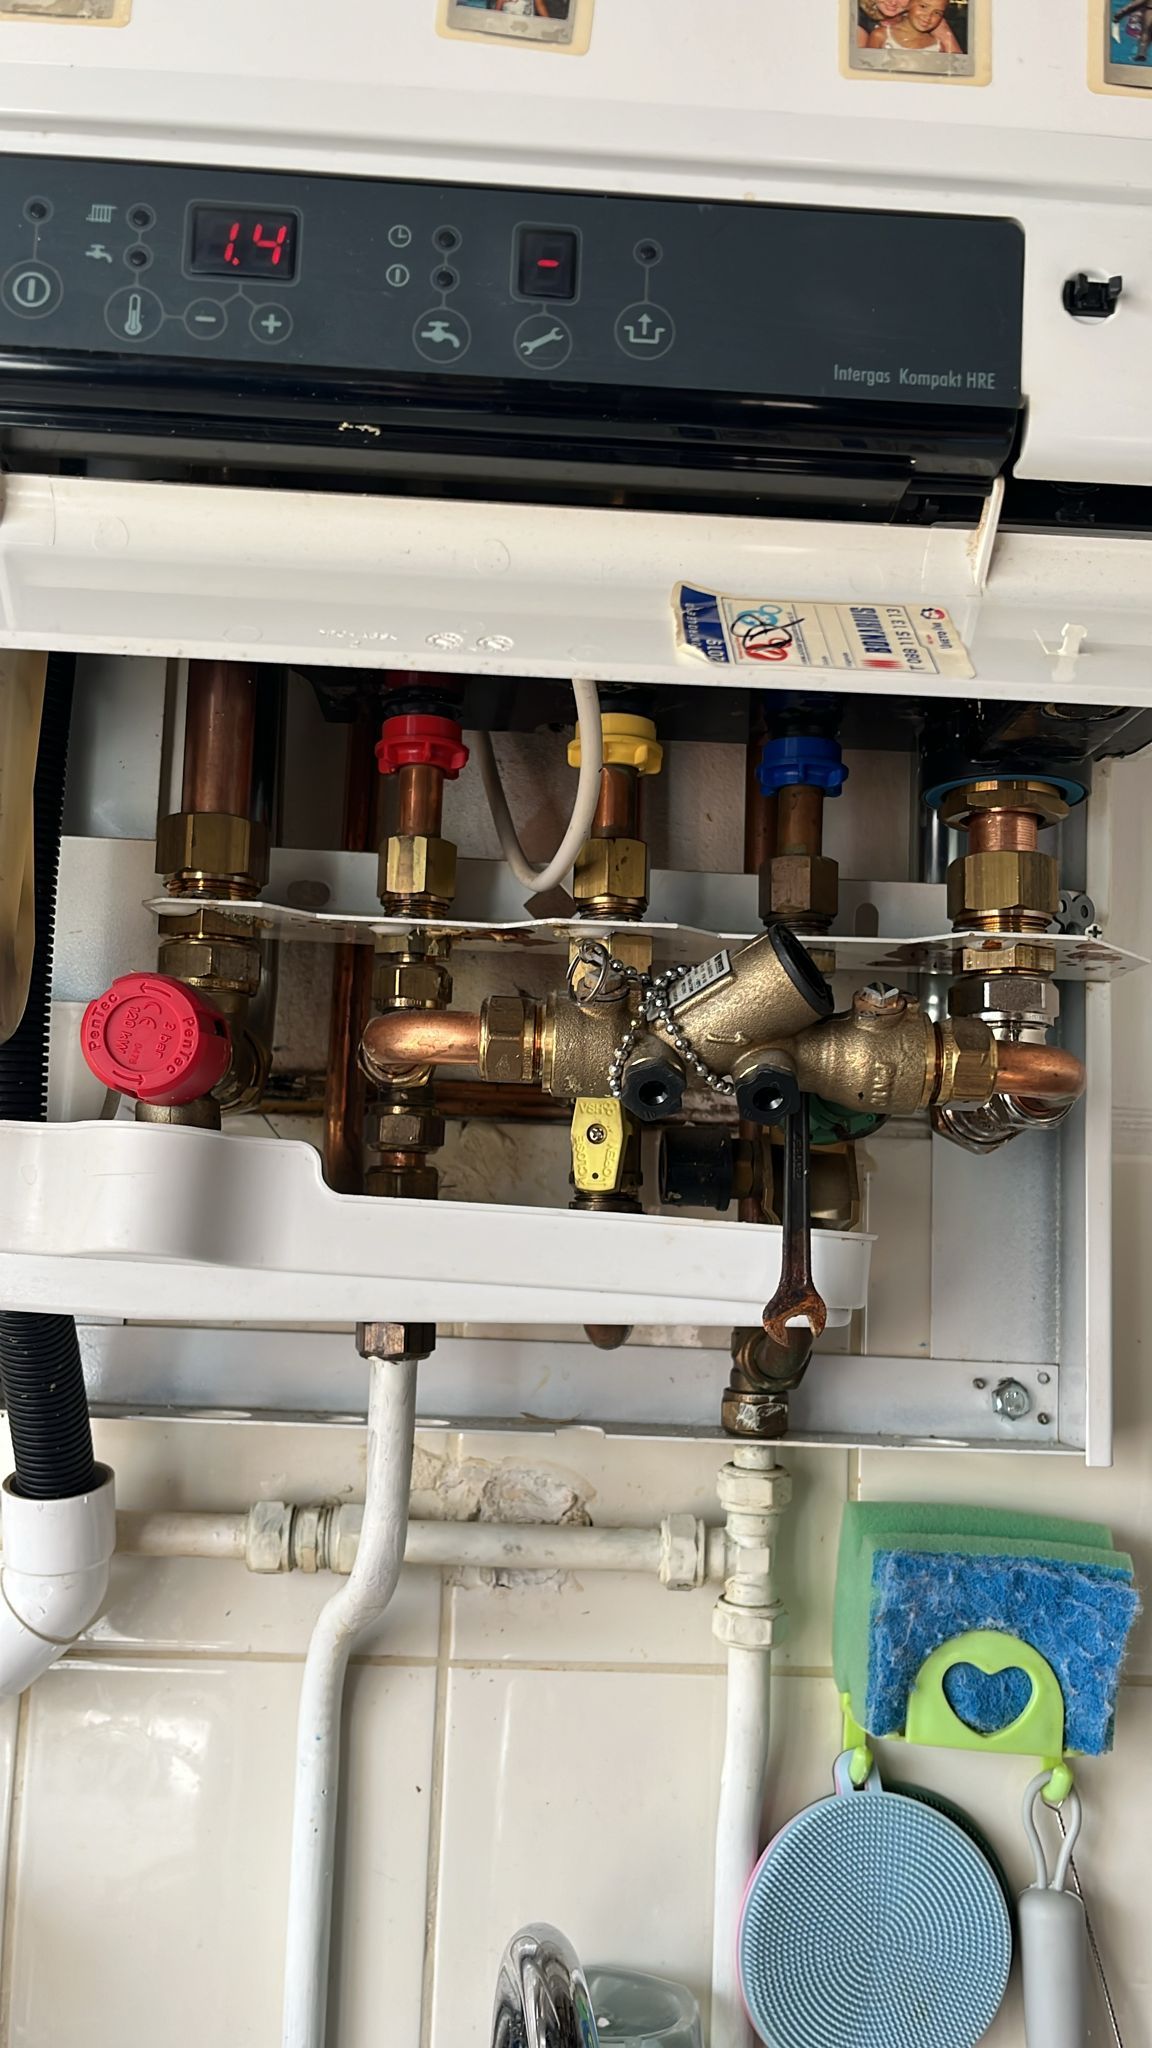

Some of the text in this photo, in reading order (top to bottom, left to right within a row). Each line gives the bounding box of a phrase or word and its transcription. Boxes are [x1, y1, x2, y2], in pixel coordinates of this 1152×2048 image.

[833, 364, 996, 390] Intergas Kompakt HRE
[886, 607, 902, 618] 13
[890, 619, 908, 629] 13
[849, 607, 892, 653] BONARIUS
[895, 631, 915, 646] 115
[706, 639, 725, 662] 2019
[902, 648, 923, 664] 088
[88, 992, 119, 1052] PenTec
[117, 1006, 141, 1056] 120 kW
[155, 1033, 172, 1060] bar
[574, 1135, 588, 1177] CLOSE
